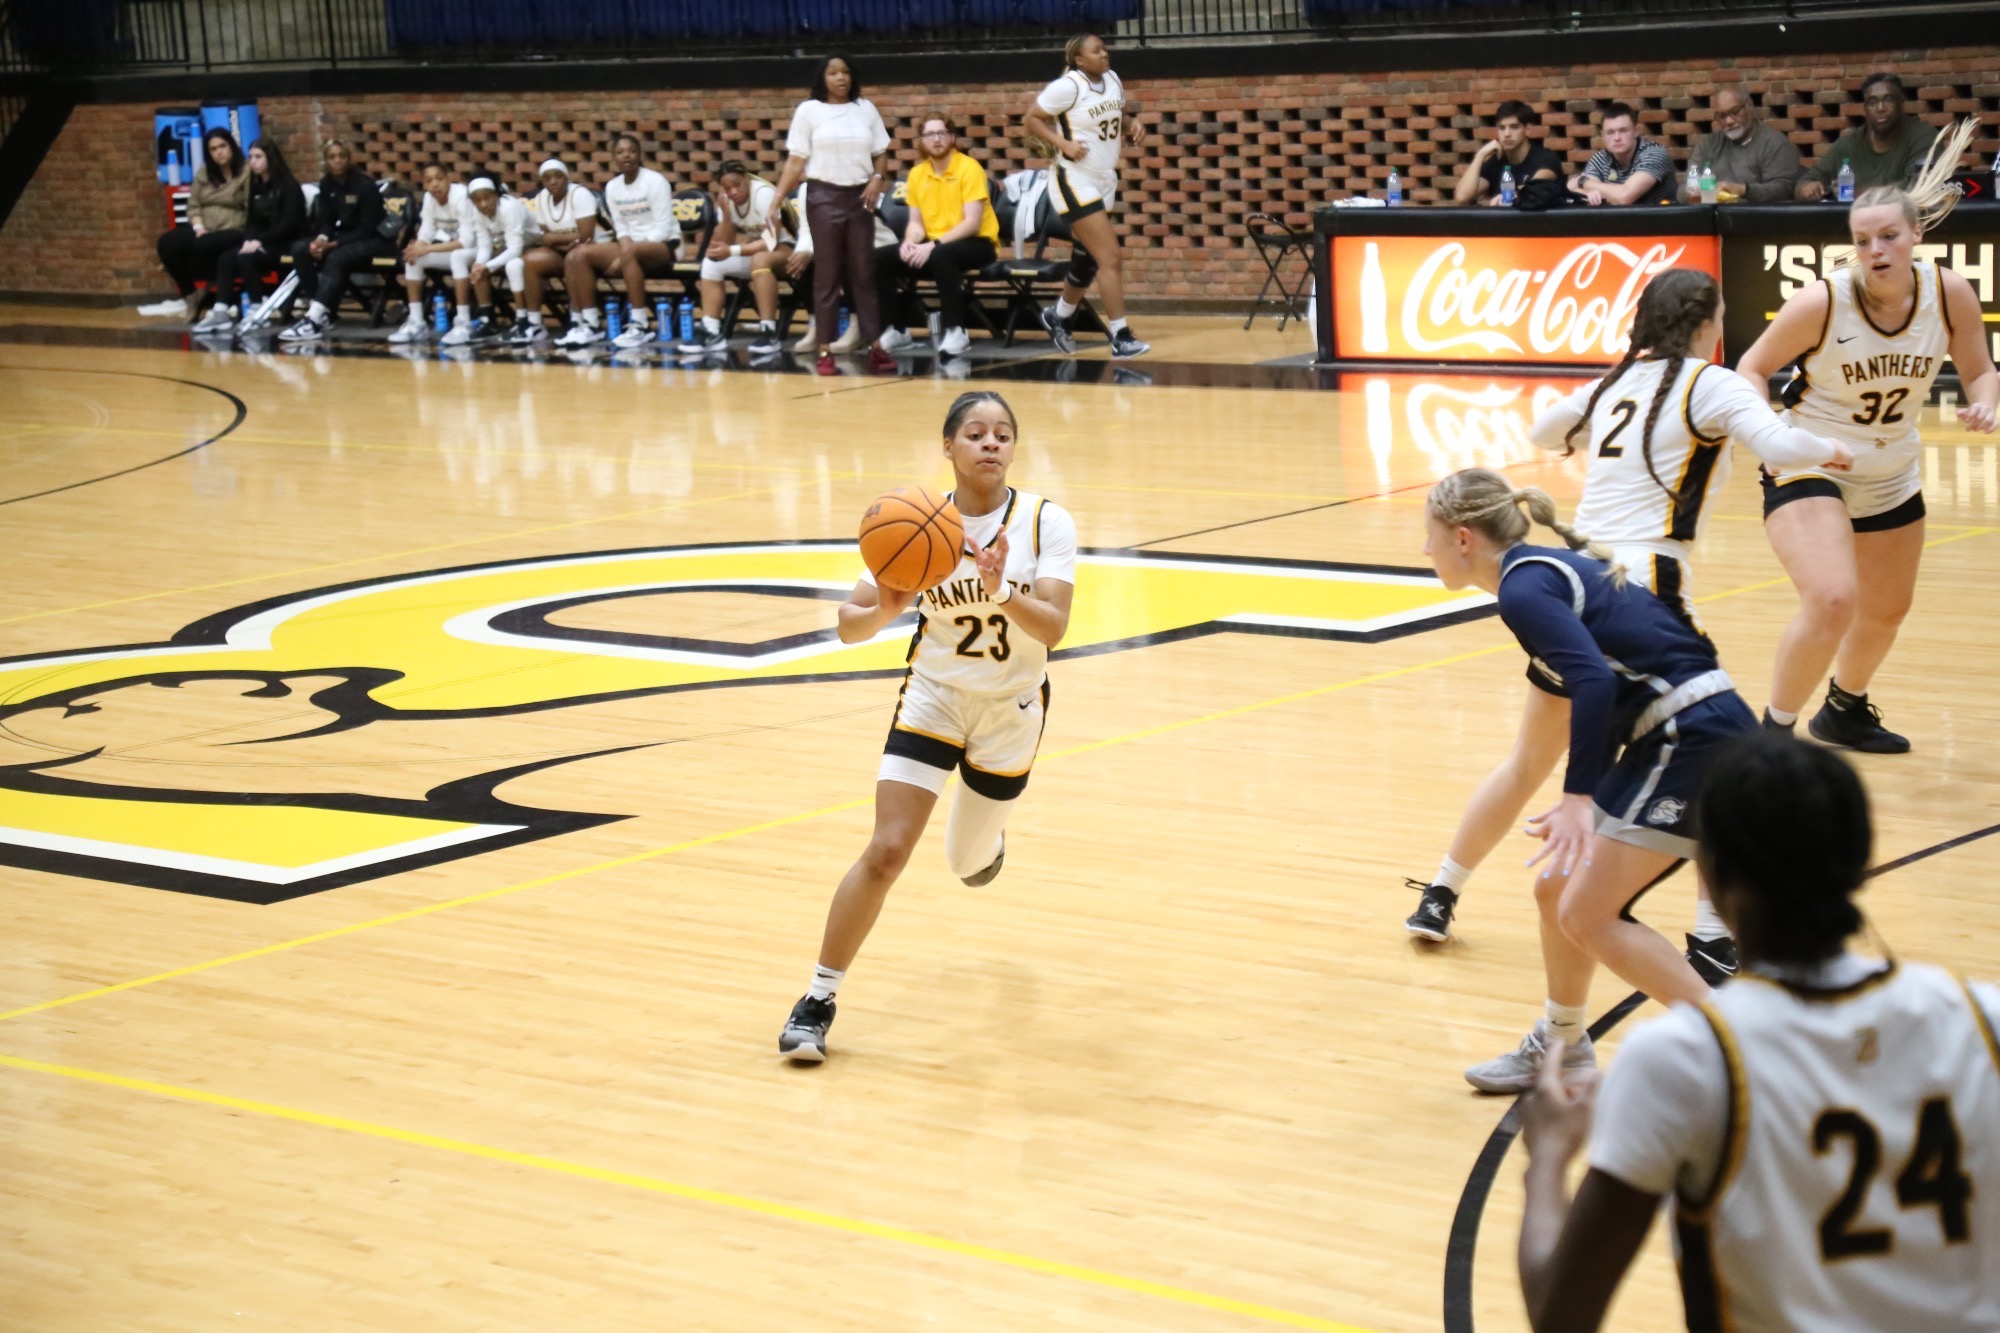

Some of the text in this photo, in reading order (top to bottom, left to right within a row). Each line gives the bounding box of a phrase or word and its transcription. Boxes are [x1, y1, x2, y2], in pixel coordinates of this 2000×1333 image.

[1098, 117, 1120, 141] 33
[1401, 242, 1687, 355] Coca-Col
[1763, 243, 1994, 301] 'STH
[1842, 353, 1933, 385] PANTHERS
[1598, 399, 1638, 458] 2
[1852, 387, 1910, 425] 32
[954, 614, 1011, 662] 23
[1812, 1096, 1975, 1263] 24
